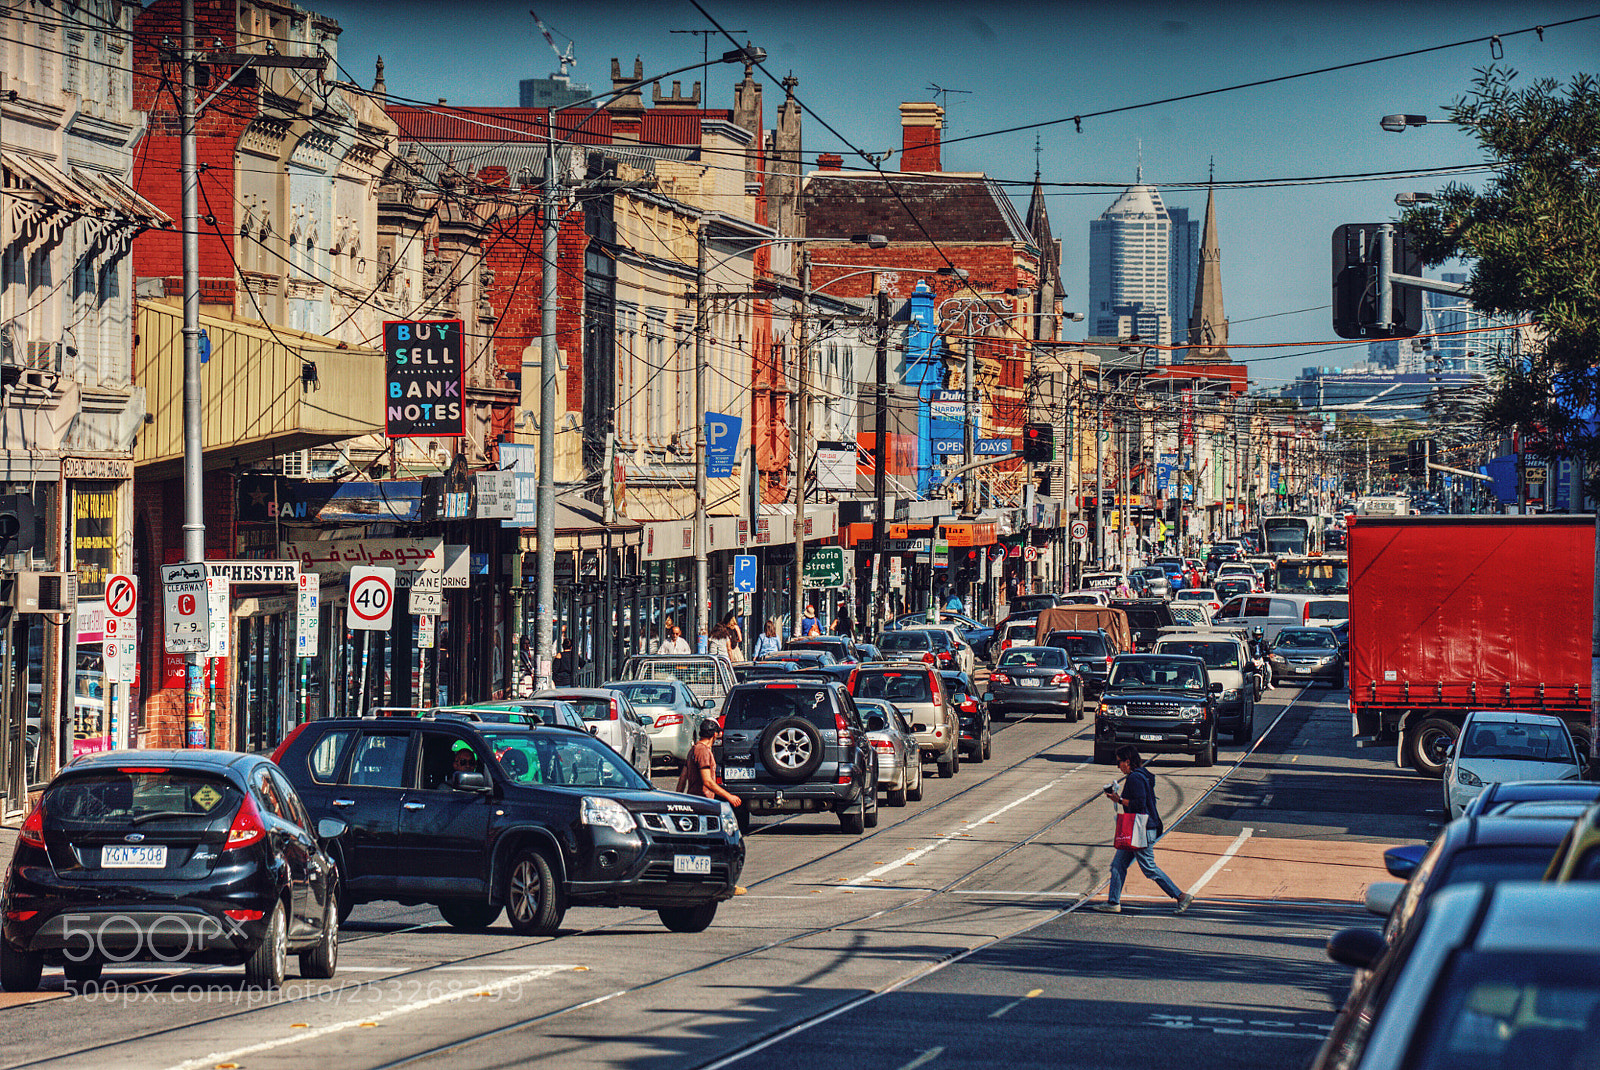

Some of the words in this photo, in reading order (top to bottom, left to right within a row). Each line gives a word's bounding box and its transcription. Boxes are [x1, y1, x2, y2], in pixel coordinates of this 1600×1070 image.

[397, 324, 450, 341] BUY
[395, 347, 454, 365] SELL
[389, 380, 460, 398] BANK
[940, 391, 966, 400] Dulu
[388, 402, 461, 422] NOTES
[710, 422, 728, 445] P
[937, 441, 964, 451] OPEN
[980, 442, 1008, 452] DAYS
[896, 540, 922, 550] COZZO
[740, 559, 750, 571] P
[805, 562, 836, 571] Street
[168, 583, 204, 592] CLEARWAY
[413, 577, 440, 588] LANE
[1089, 577, 1117, 587] VIKING
[183, 595, 192, 613] C
[356, 588, 385, 609] 40
[309, 619, 318, 628] 2P
[667, 804, 693, 812] X-TRAIL
[105, 847, 129, 861] YGN
[140, 847, 162, 861] 508
